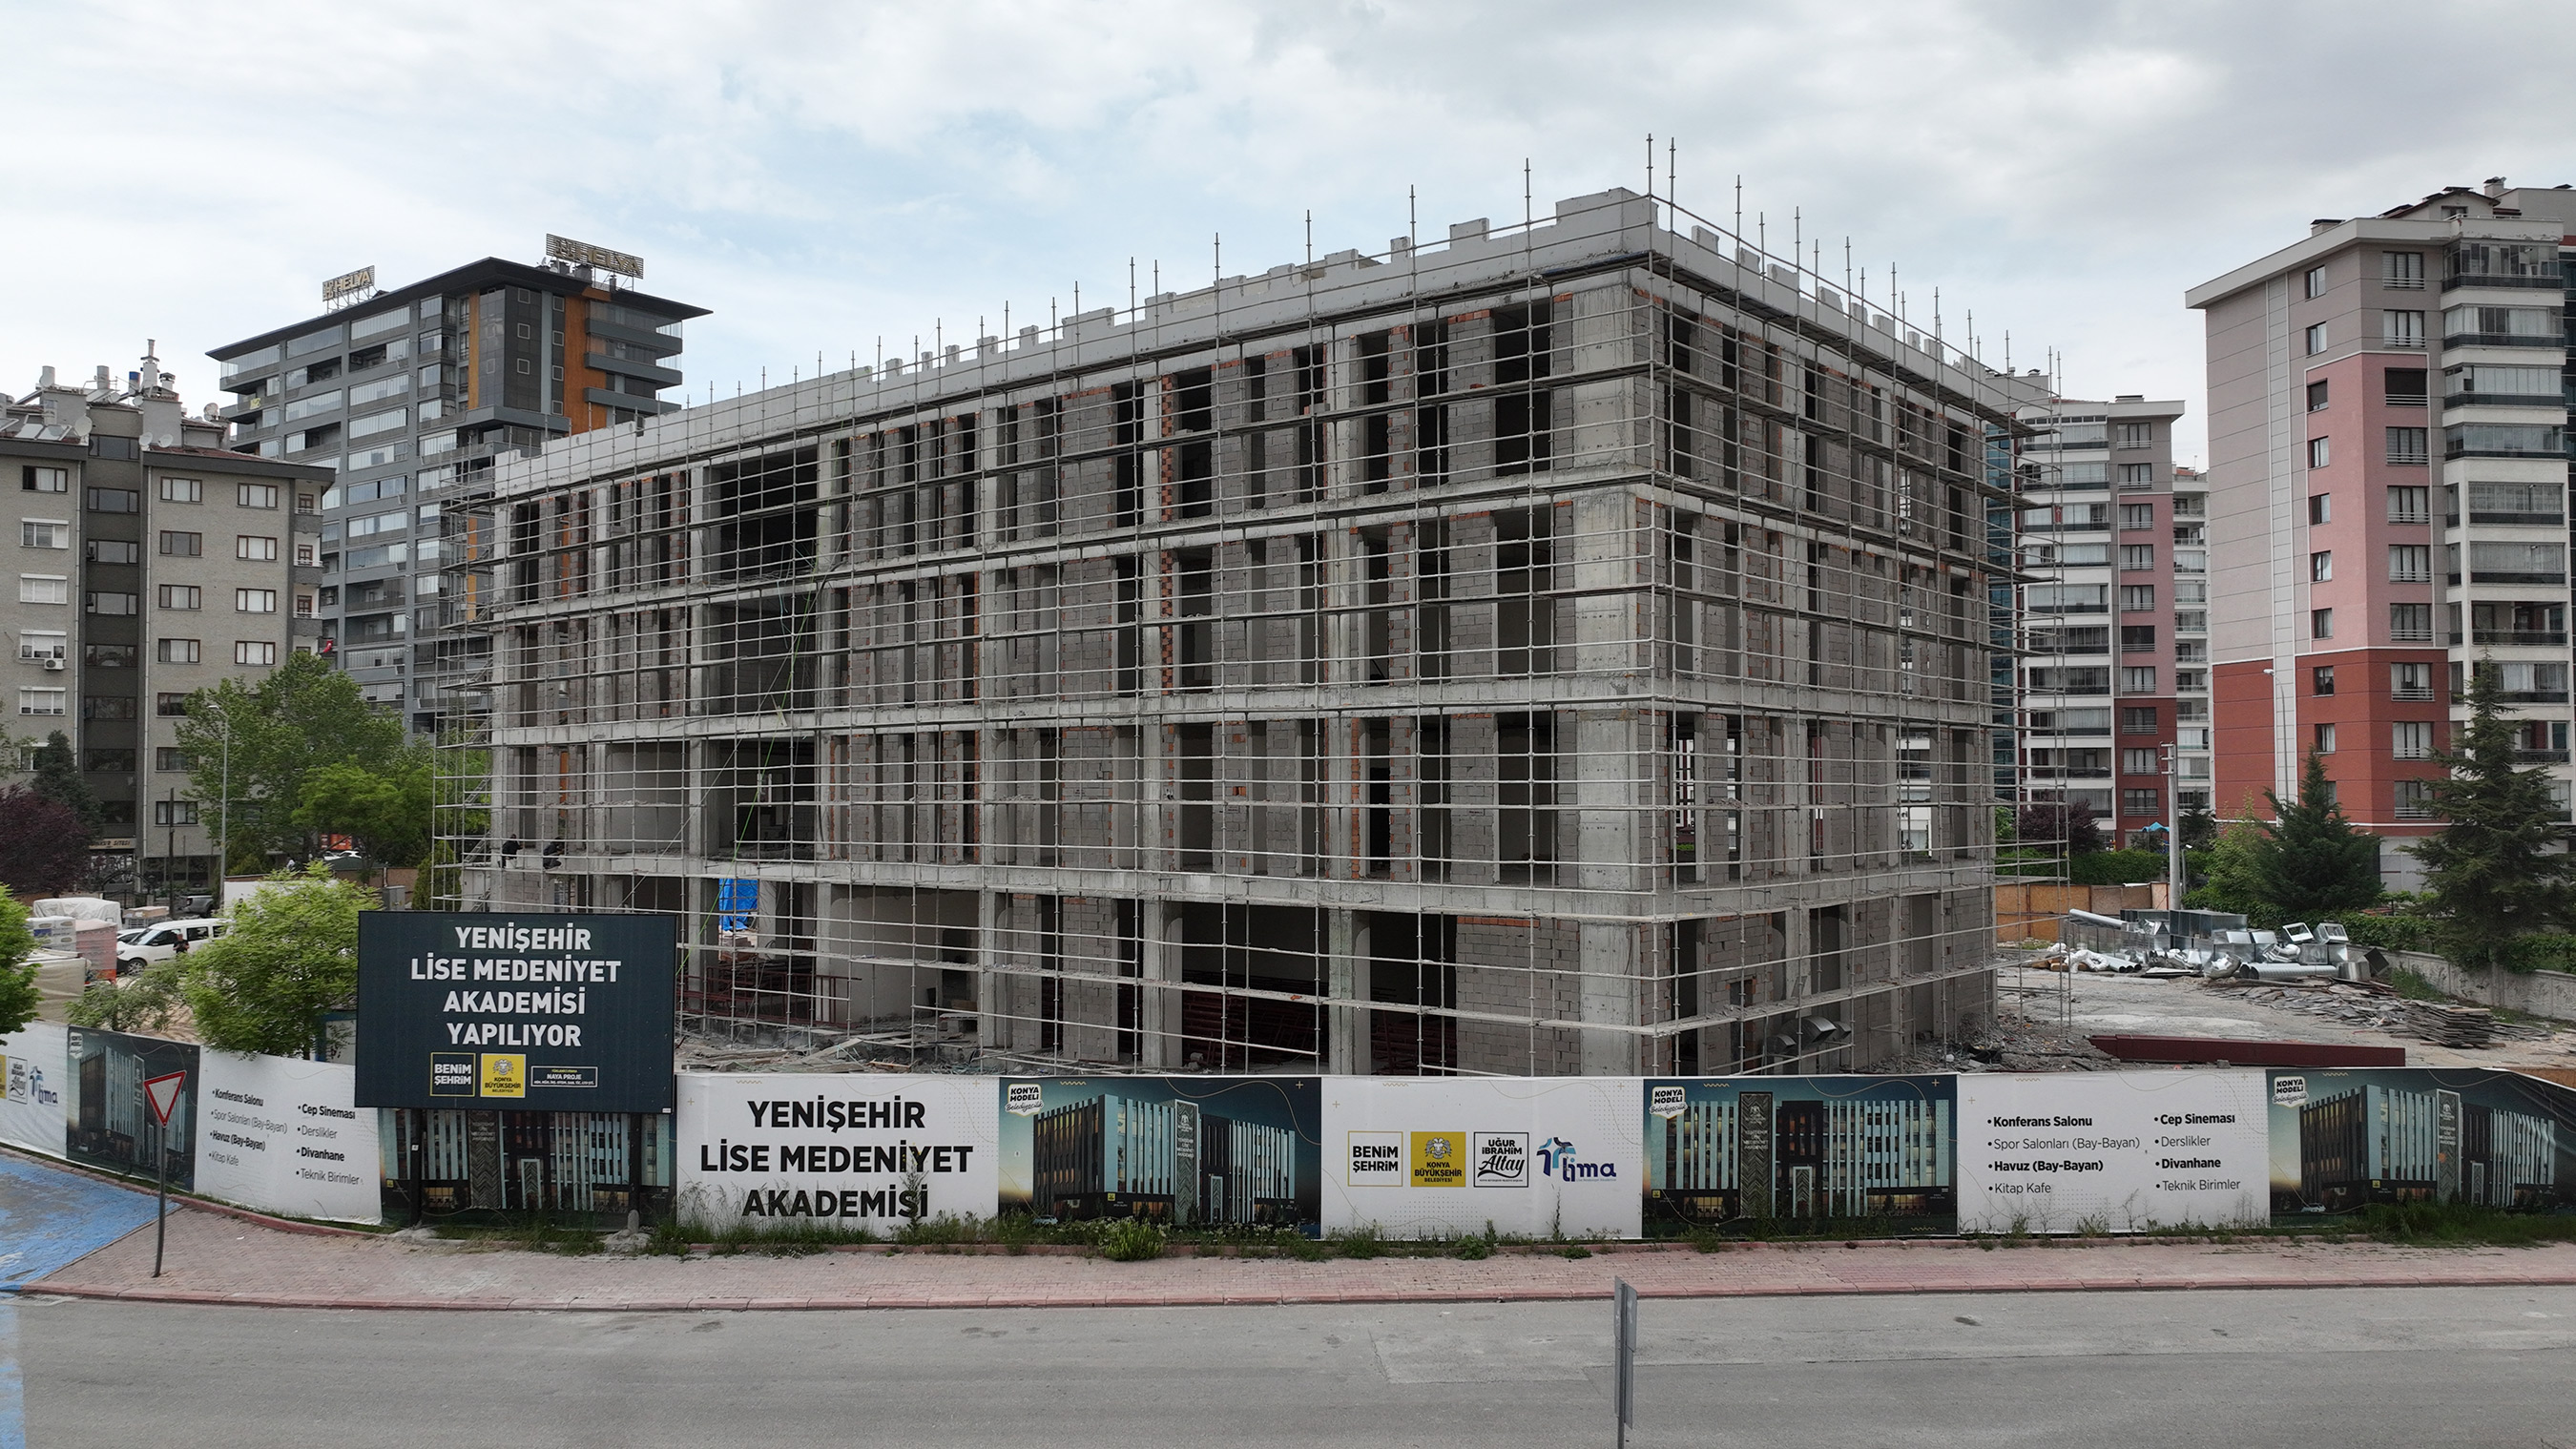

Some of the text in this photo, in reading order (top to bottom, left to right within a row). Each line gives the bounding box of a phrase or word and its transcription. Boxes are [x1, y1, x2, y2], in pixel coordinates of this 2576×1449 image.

[335, 271, 371, 292] HELYA
[455, 922, 591, 953] YENİŞEHİR
[411, 953, 621, 982] LİSE MEDENİYET
[443, 986, 585, 1014] AKADEMİSİ
[447, 1023, 581, 1046] YAPILIYOR
[302, 1103, 355, 1119] Cep Sineması
[747, 1095, 924, 1133] YENİŞEHİR
[1994, 1116, 2092, 1127] Konferans Salonu
[2160, 1113, 2234, 1126] Cep Sineması
[302, 1125, 337, 1138] Derslikler
[231, 1134, 265, 1151] (Bay-Bayan)
[1488, 1137, 1515, 1147] UĞUR
[1994, 1137, 2140, 1150] Spor Salonları (Bay-Bayan)
[2162, 1135, 2211, 1147] Derslikler
[301, 1147, 345, 1161] Divanhane
[701, 1139, 973, 1173] LİSE MEDENİYET
[1478, 1155, 1525, 1178] Altay
[1995, 1160, 2103, 1172] Havuz (Bay-Bayan)
[2162, 1158, 2221, 1169] Divanhane
[301, 1168, 359, 1184] Teknik Birimler
[1415, 1168, 1462, 1177] BÜYÜKŞEHİR
[1995, 1183, 2051, 1195] Kitap Kafe
[2162, 1179, 2240, 1190] Teknik Birimler
[742, 1184, 929, 1218] AKADEMİSİ
